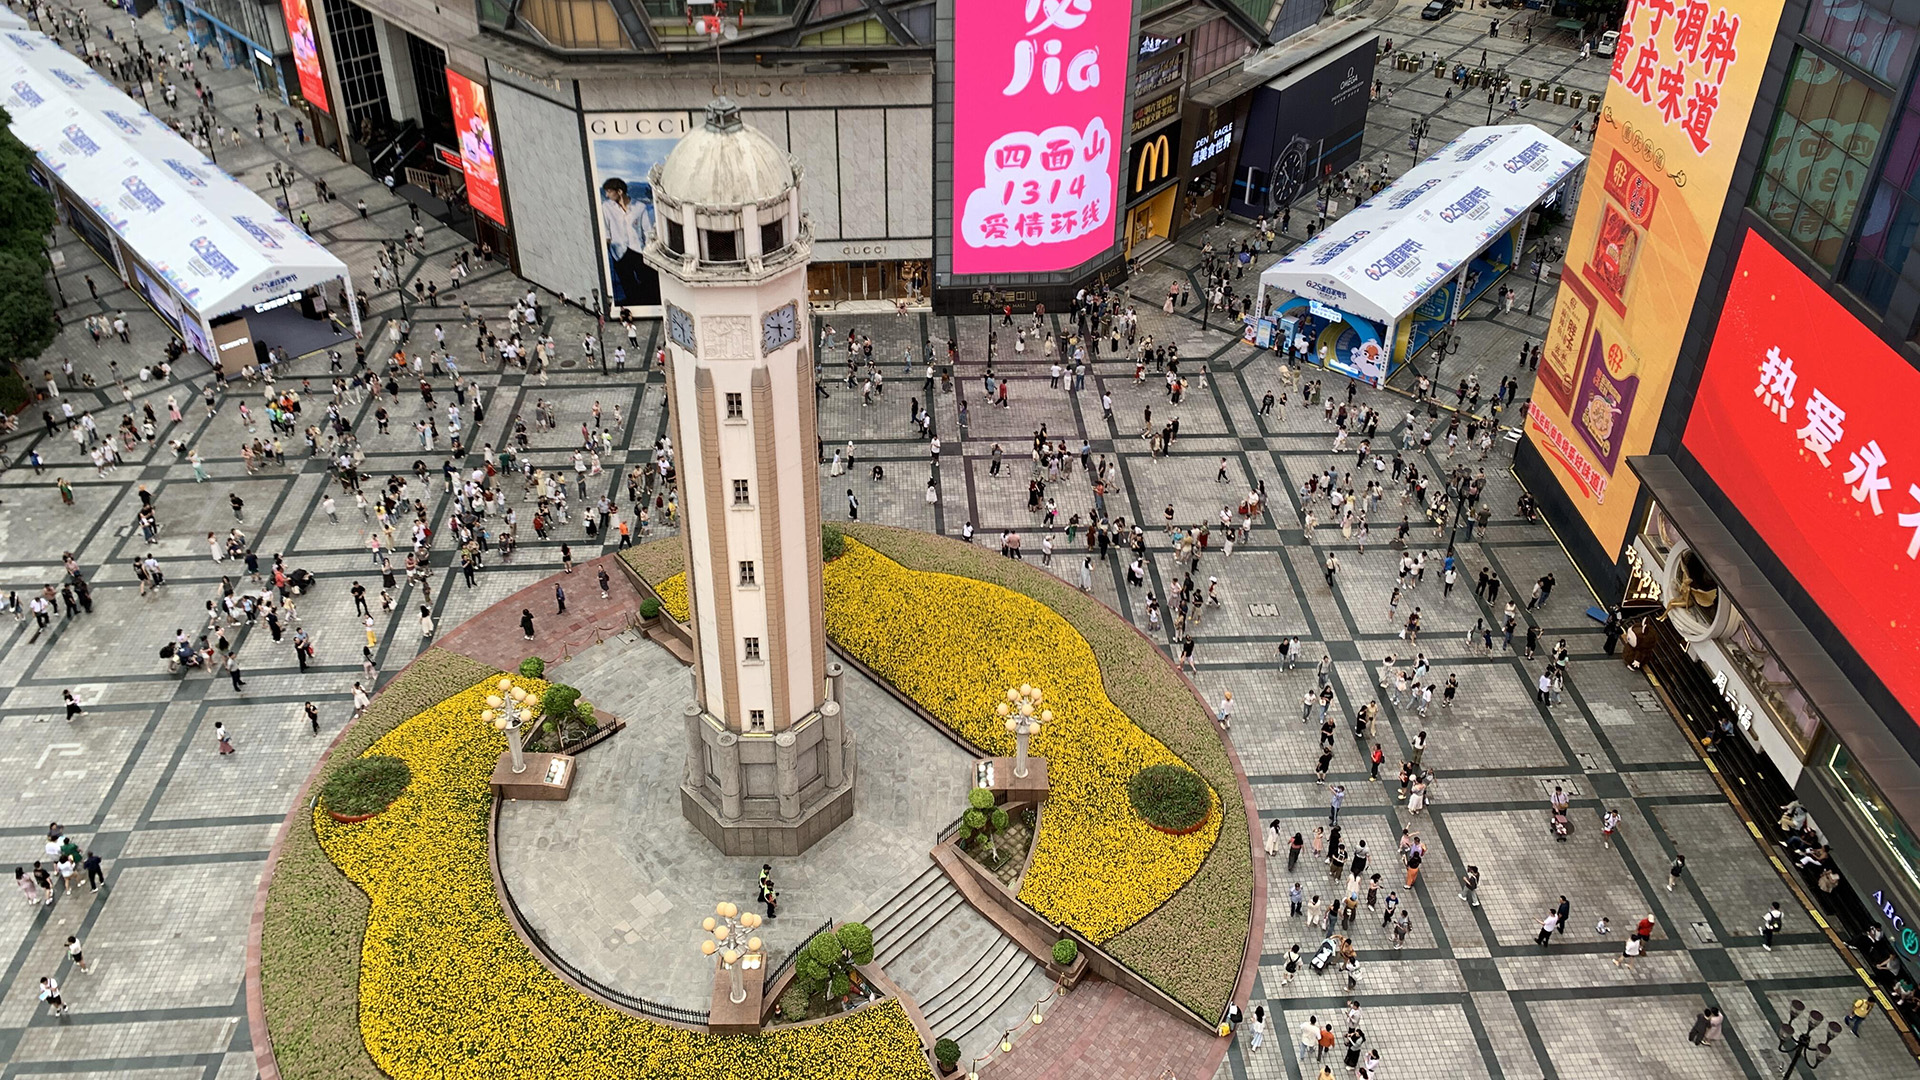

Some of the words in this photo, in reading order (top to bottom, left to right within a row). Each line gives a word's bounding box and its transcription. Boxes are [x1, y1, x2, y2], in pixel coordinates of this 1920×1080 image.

[1003, 39, 1100, 96] Jia
[1610, 22, 1720, 153] 重庆味道
[590, 118, 686, 136] GUCCI
[1213, 122, 1233, 139] EAGLE
[995, 129, 1105, 171] 四面山
[1002, 174, 1087, 206] 1314
[979, 198, 1100, 240] 爱情环线
[842, 245, 887, 255] GUCCI
[1104, 266, 1121, 280] EAGLE
[1712, 670, 1754, 731] 周六福
[1872, 890, 1904, 932] ABC
